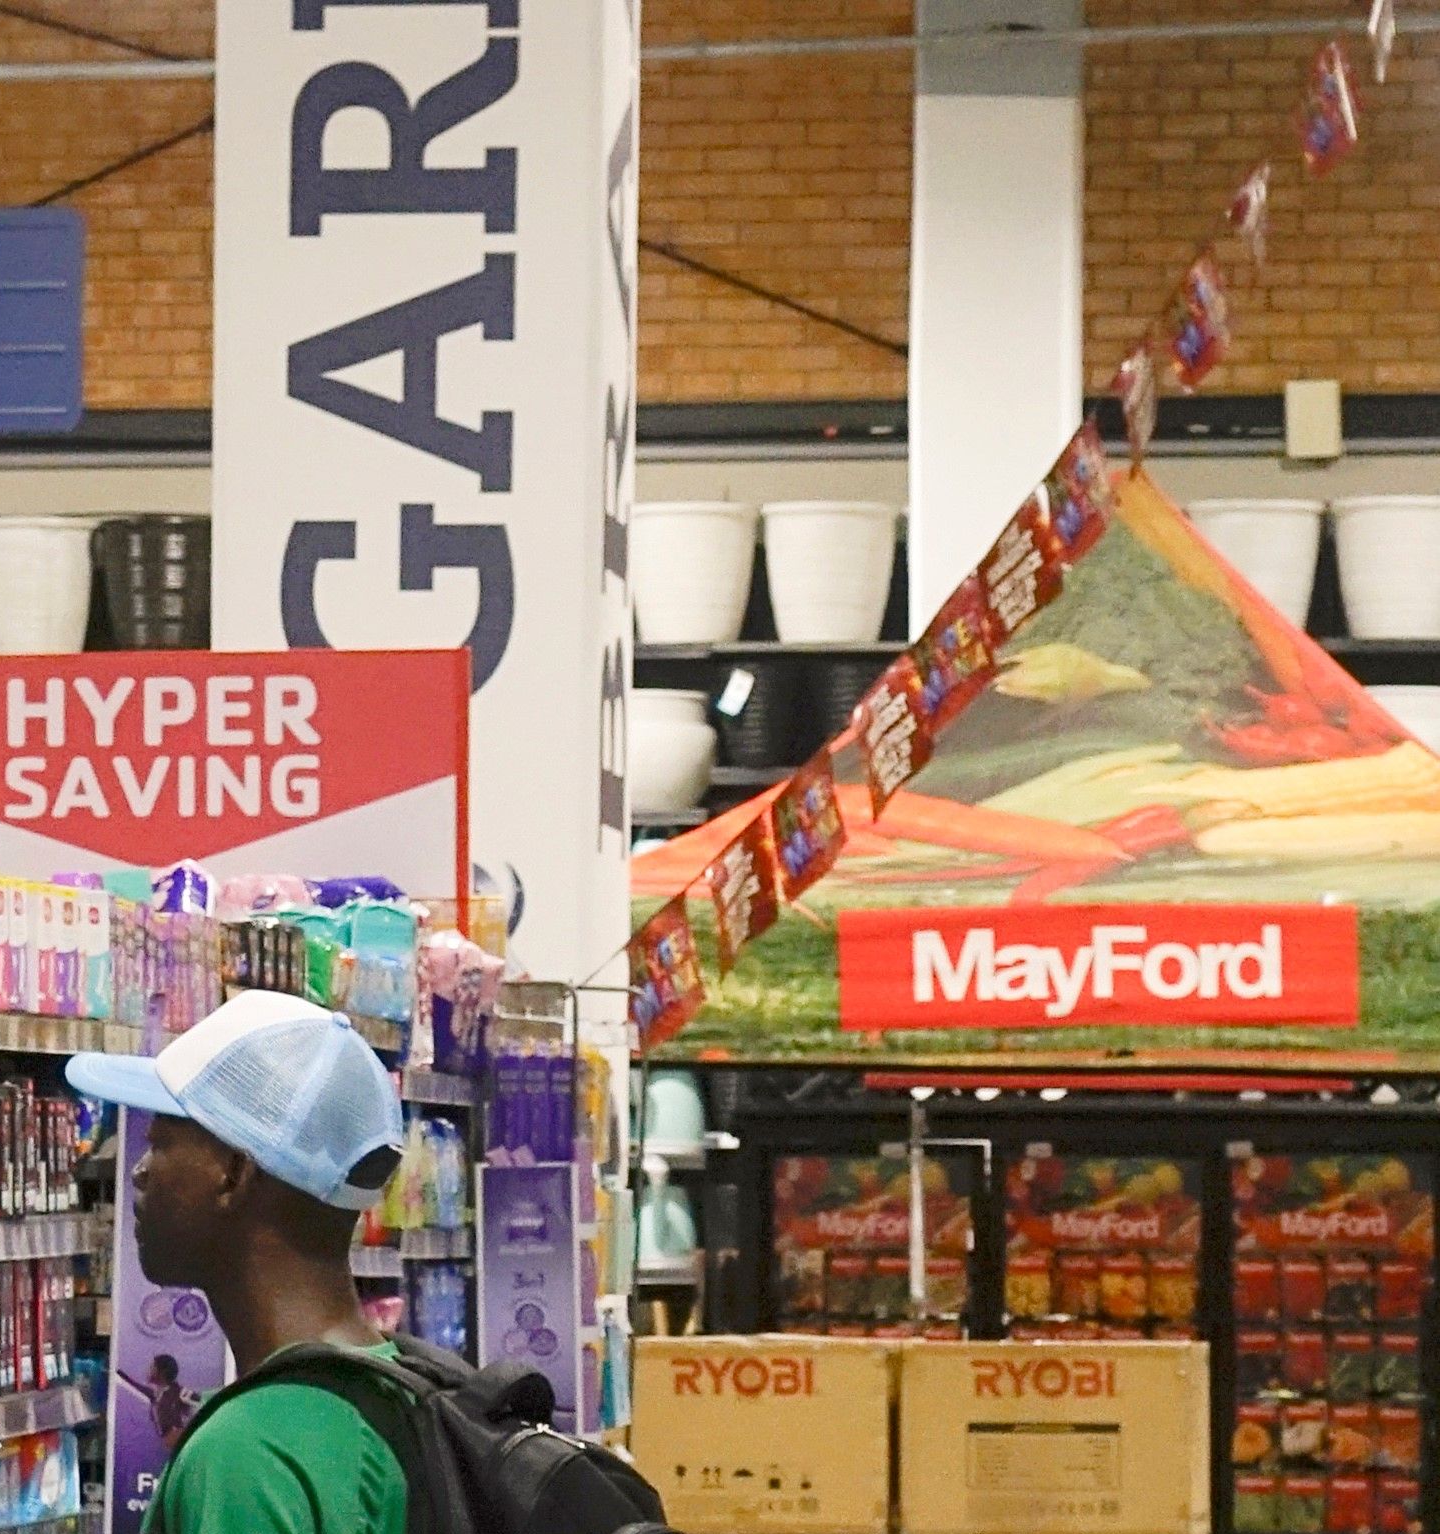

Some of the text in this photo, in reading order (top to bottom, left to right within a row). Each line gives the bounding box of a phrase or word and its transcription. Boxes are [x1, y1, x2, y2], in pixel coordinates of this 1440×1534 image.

[5, 675, 321, 748] HYPER
[3, 755, 321, 819] SAVING
[912, 924, 1283, 1019] MayFord
[1051, 1210, 1160, 1241] MayFord
[1279, 1211, 1387, 1239] MayFord
[671, 1358, 814, 1398] RYOBI
[972, 1360, 1116, 1400] RYOBI
